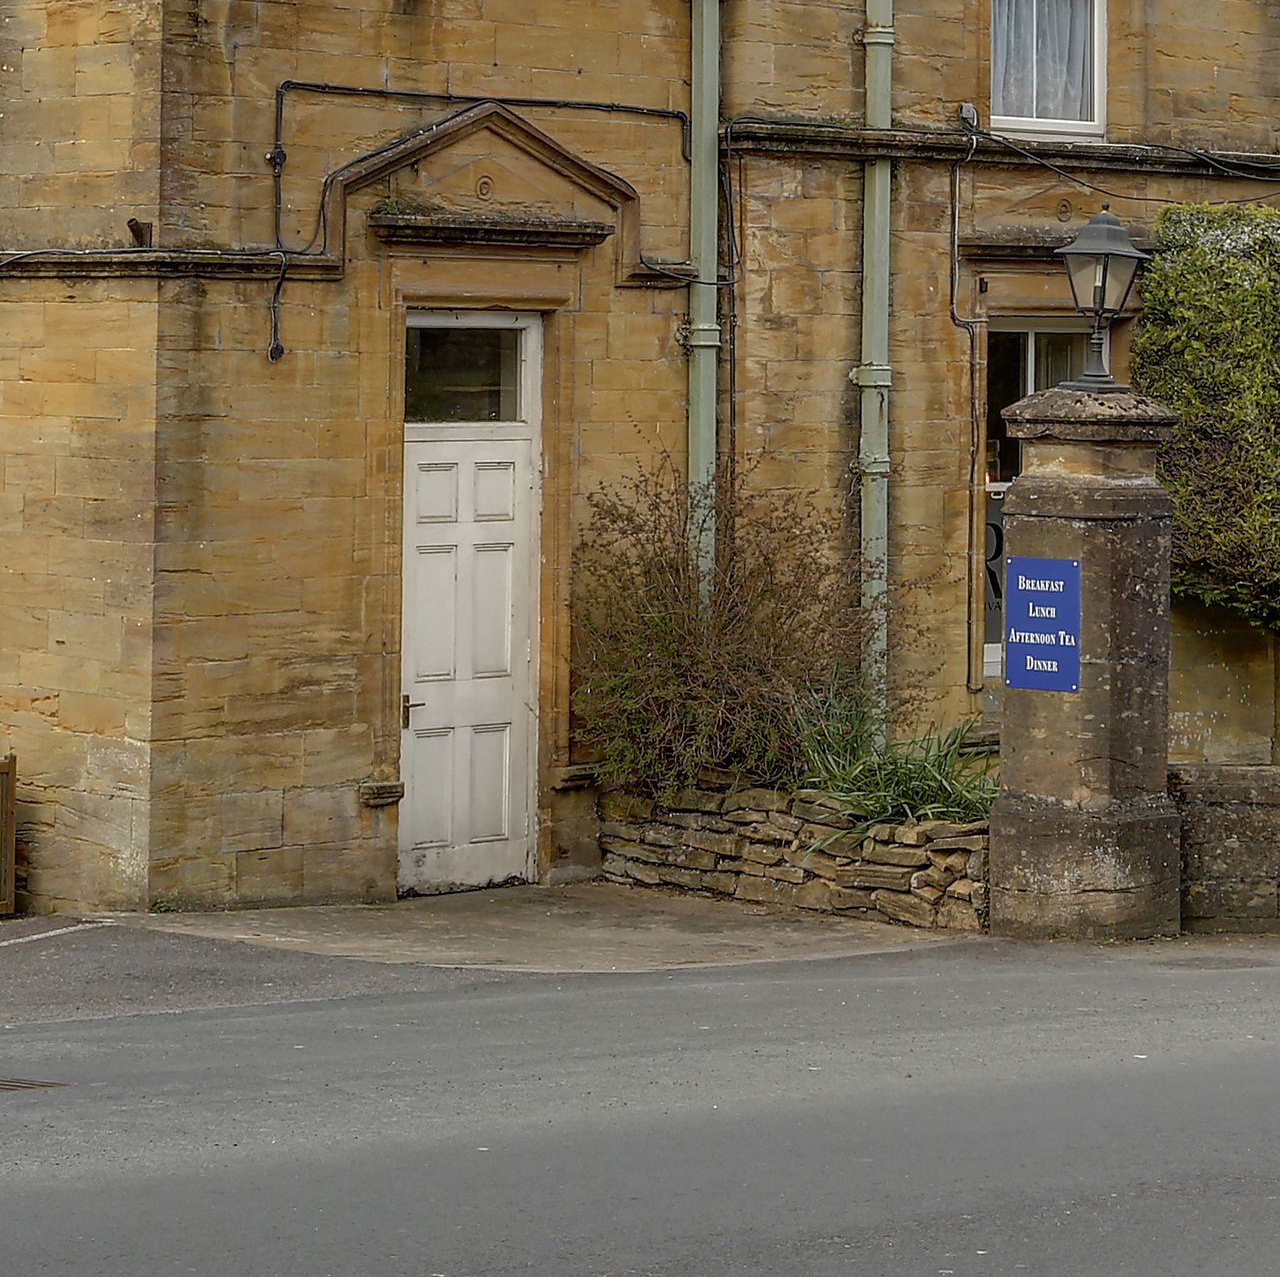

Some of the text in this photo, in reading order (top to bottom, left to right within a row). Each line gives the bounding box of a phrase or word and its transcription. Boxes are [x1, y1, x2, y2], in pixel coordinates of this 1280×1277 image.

[1028, 602, 1056, 618] LUNCH
[1009, 628, 1056, 645] AFTERNOON
[1026, 655, 1058, 672] DINNER
